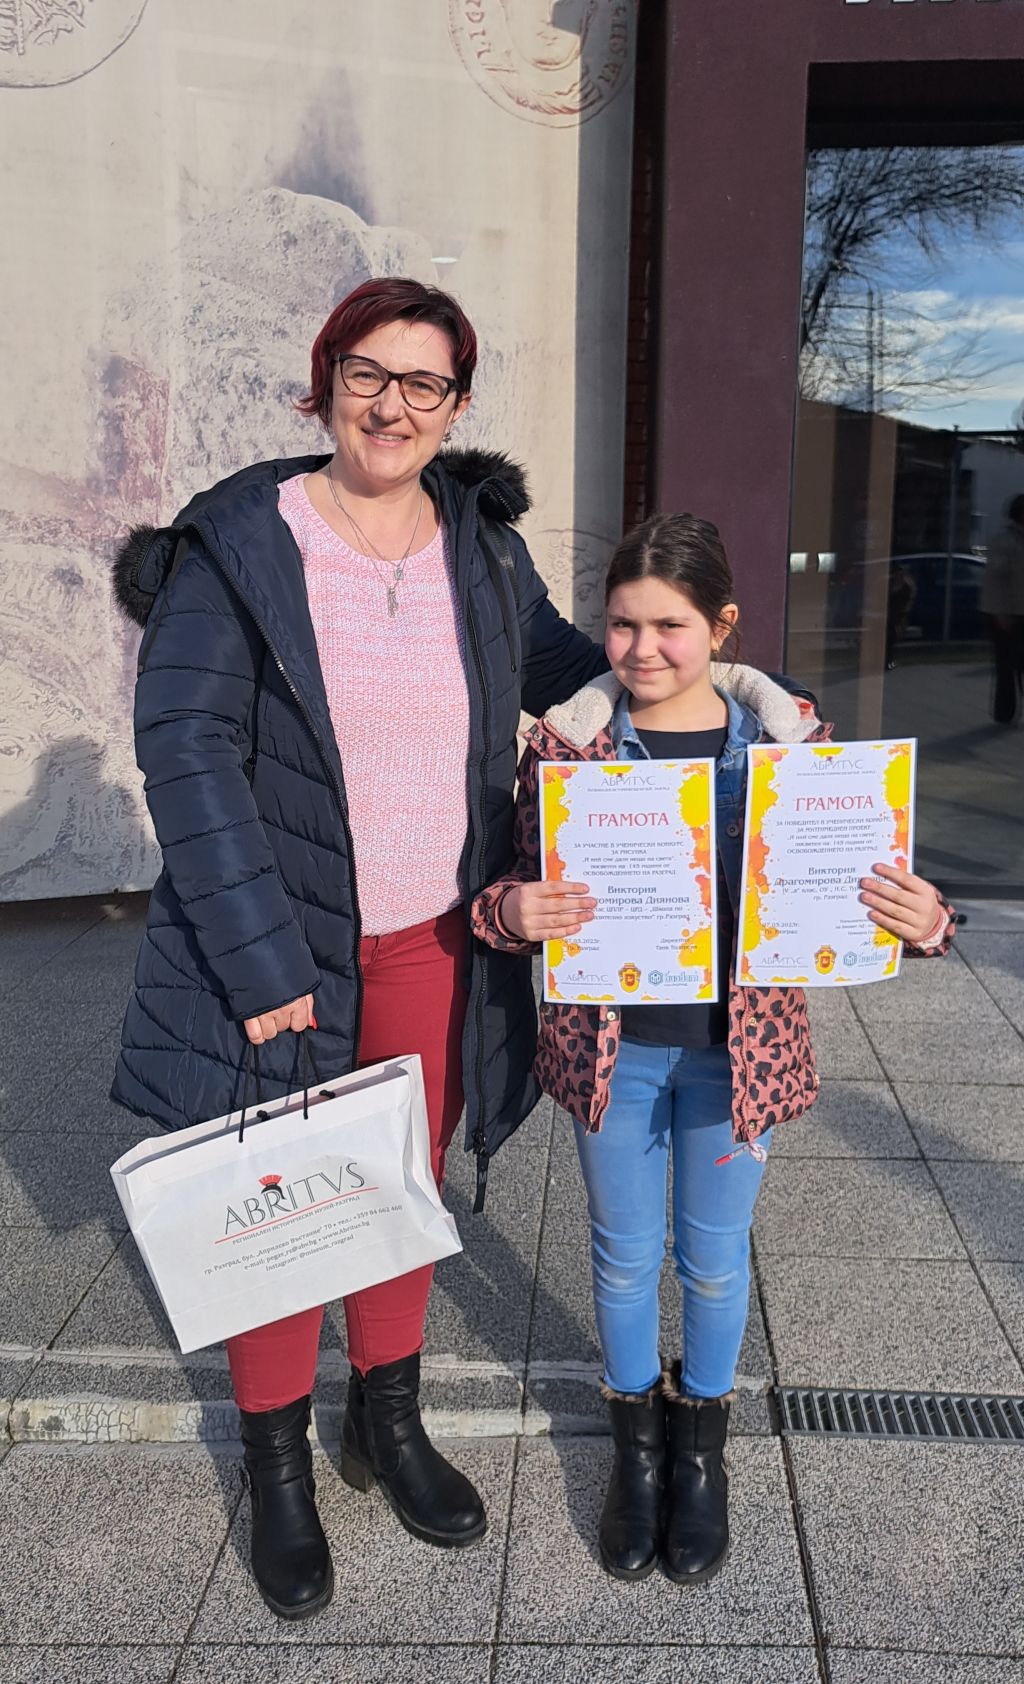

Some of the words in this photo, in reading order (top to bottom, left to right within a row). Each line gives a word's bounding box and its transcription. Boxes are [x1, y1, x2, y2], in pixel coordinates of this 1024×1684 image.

[795, 795, 874, 811] ГРАМОТА
[588, 812, 670, 828] ГРАМОТА
[808, 867, 856, 876] Виктория
[774, 876, 841, 887] Драгомирова
[607, 885, 657, 896] Виктория
[224, 1161, 366, 1236] ABRITVS
